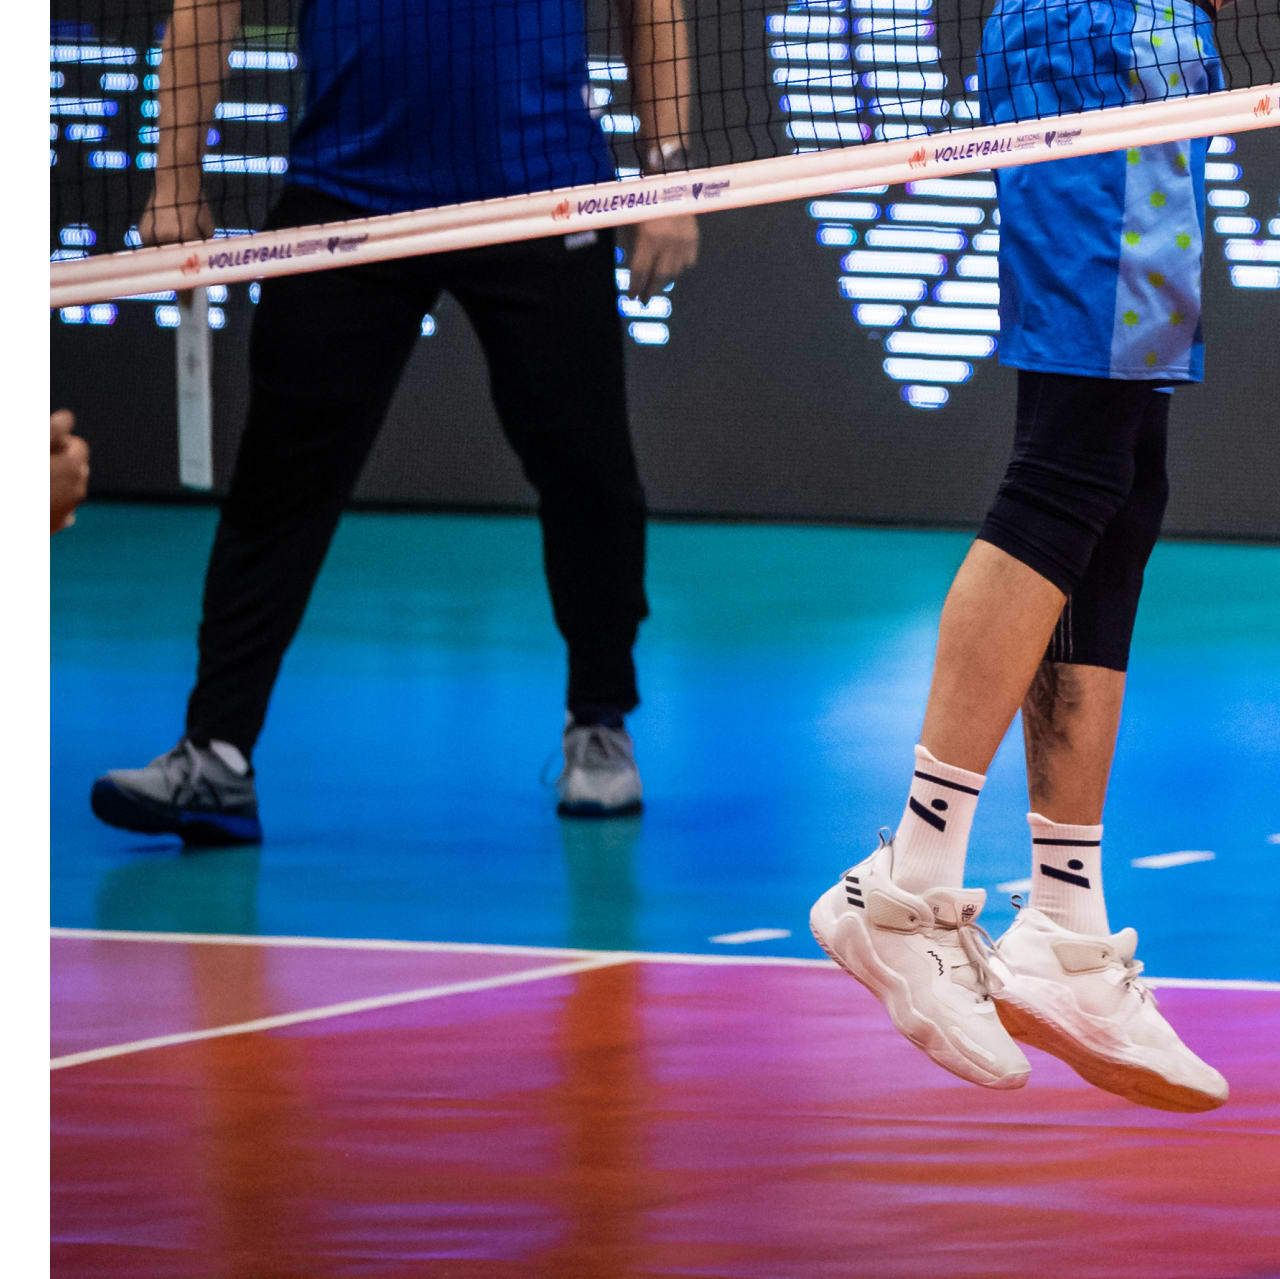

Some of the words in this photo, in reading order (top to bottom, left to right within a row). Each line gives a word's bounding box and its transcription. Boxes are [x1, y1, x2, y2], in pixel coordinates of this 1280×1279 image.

[935, 138, 1012, 163] VOLLEYBALL
[577, 190, 658, 215] VOLLEYBALL
[208, 243, 293, 269] VOLLEYBALL
